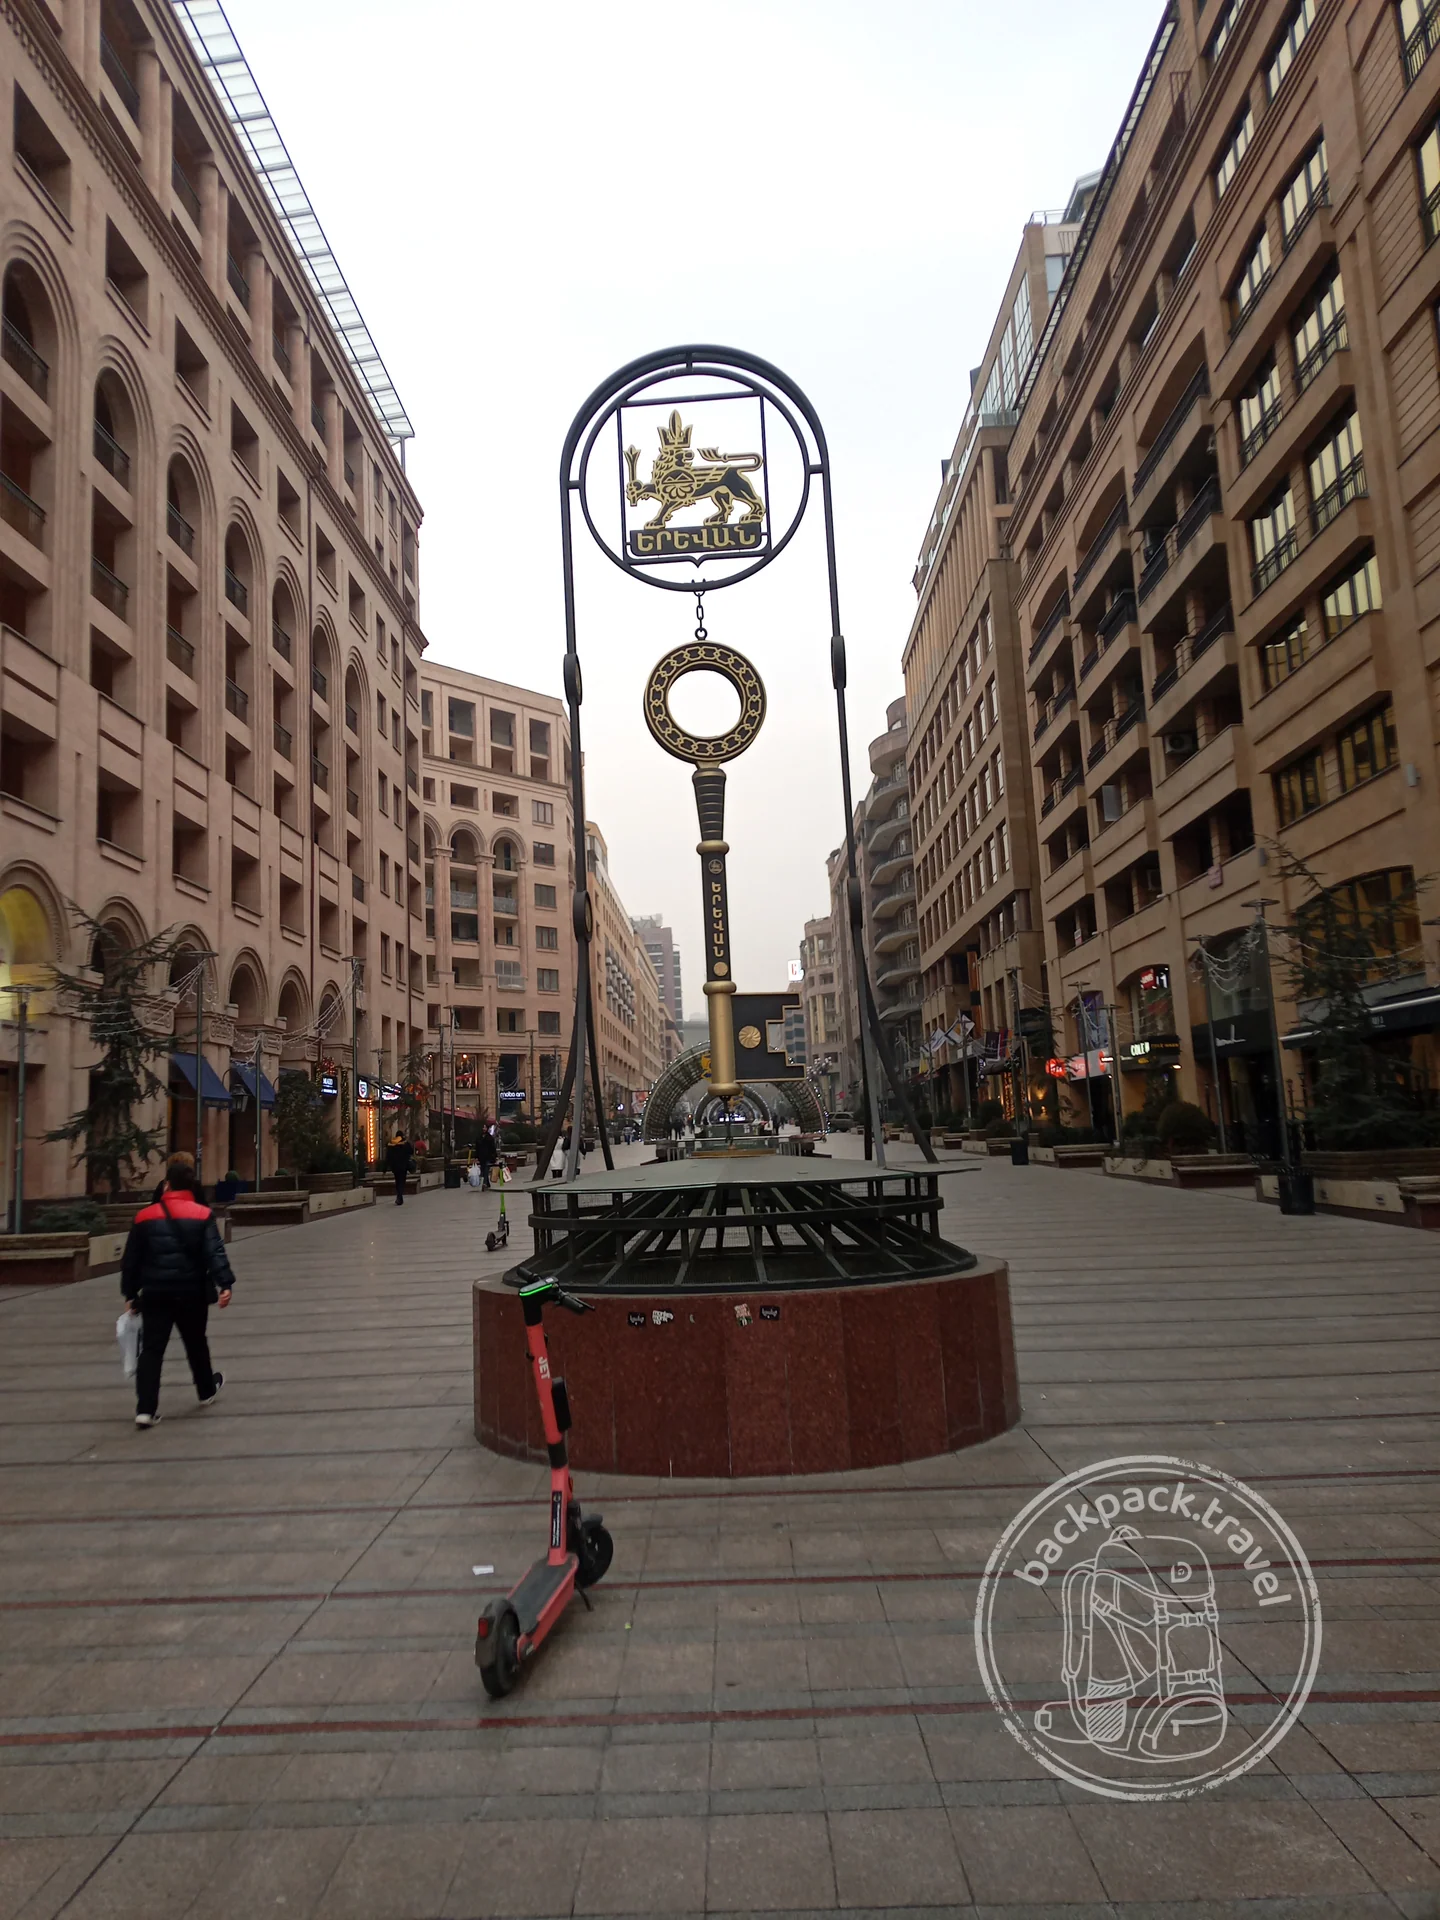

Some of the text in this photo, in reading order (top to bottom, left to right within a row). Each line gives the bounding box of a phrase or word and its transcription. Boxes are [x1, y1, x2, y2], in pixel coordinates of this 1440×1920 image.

[636, 527, 756, 552] ԵՐԵՎԱՆ
[711, 881, 725, 957] ԵՐԵՎԱՆ
[538, 1356, 551, 1379] JET
